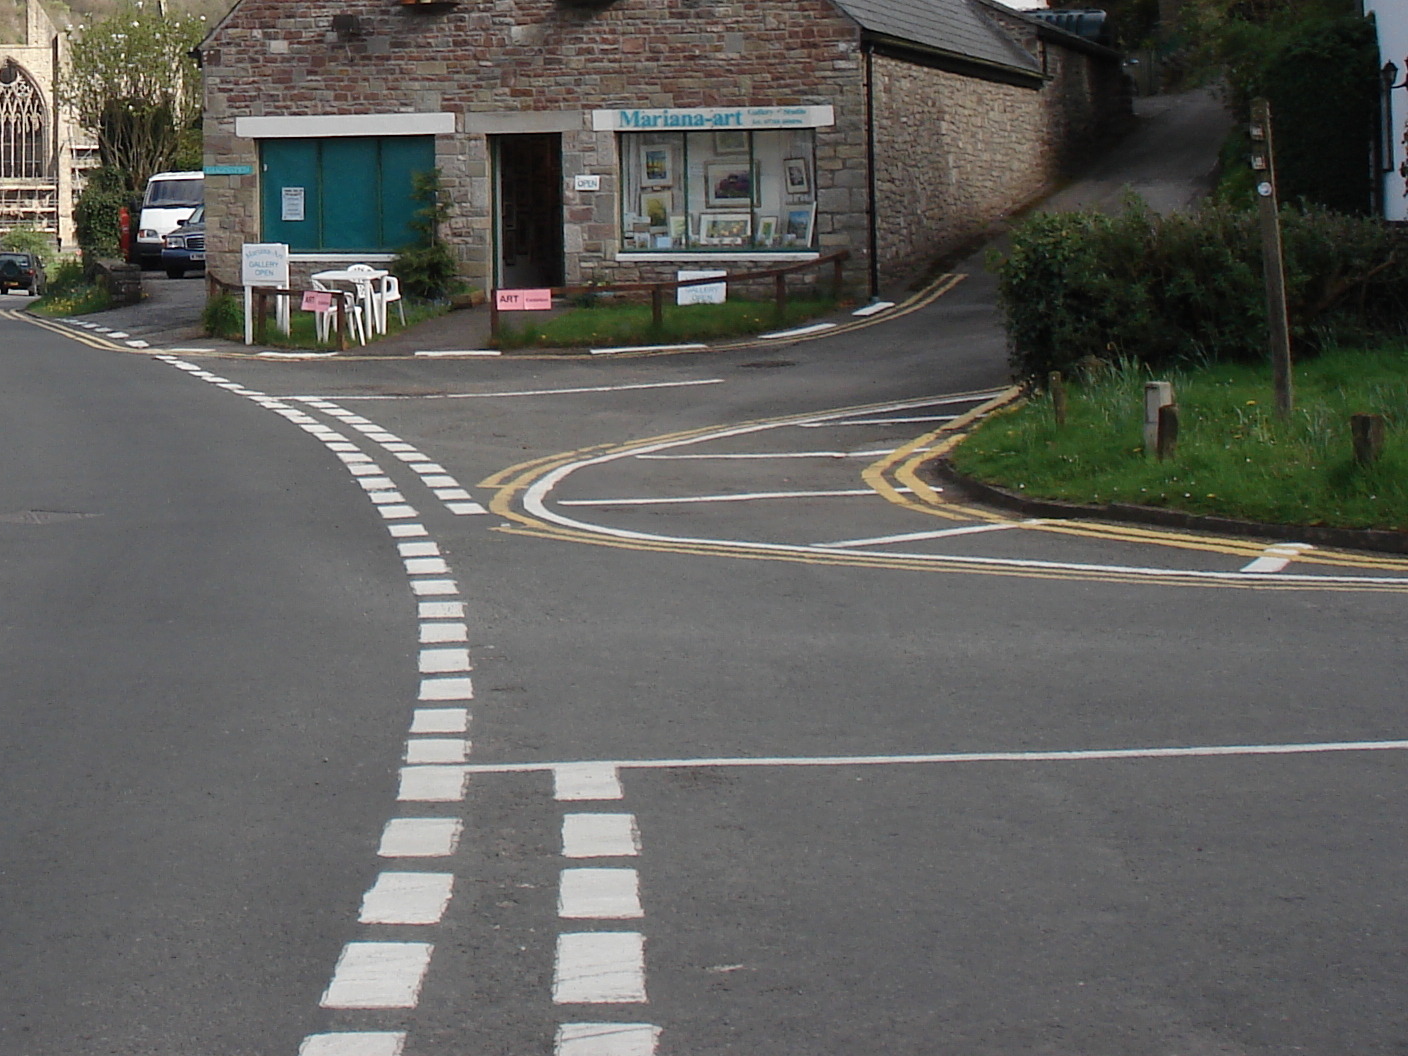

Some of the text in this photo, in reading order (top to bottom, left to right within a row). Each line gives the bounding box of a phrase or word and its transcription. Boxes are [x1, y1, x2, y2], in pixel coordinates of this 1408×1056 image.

[619, 109, 742, 128] Mariana-art
[577, 179, 598, 189] OPEN
[248, 260, 279, 269] GALLERY
[254, 269, 274, 277] OPEN
[499, 294, 520, 303] ART
